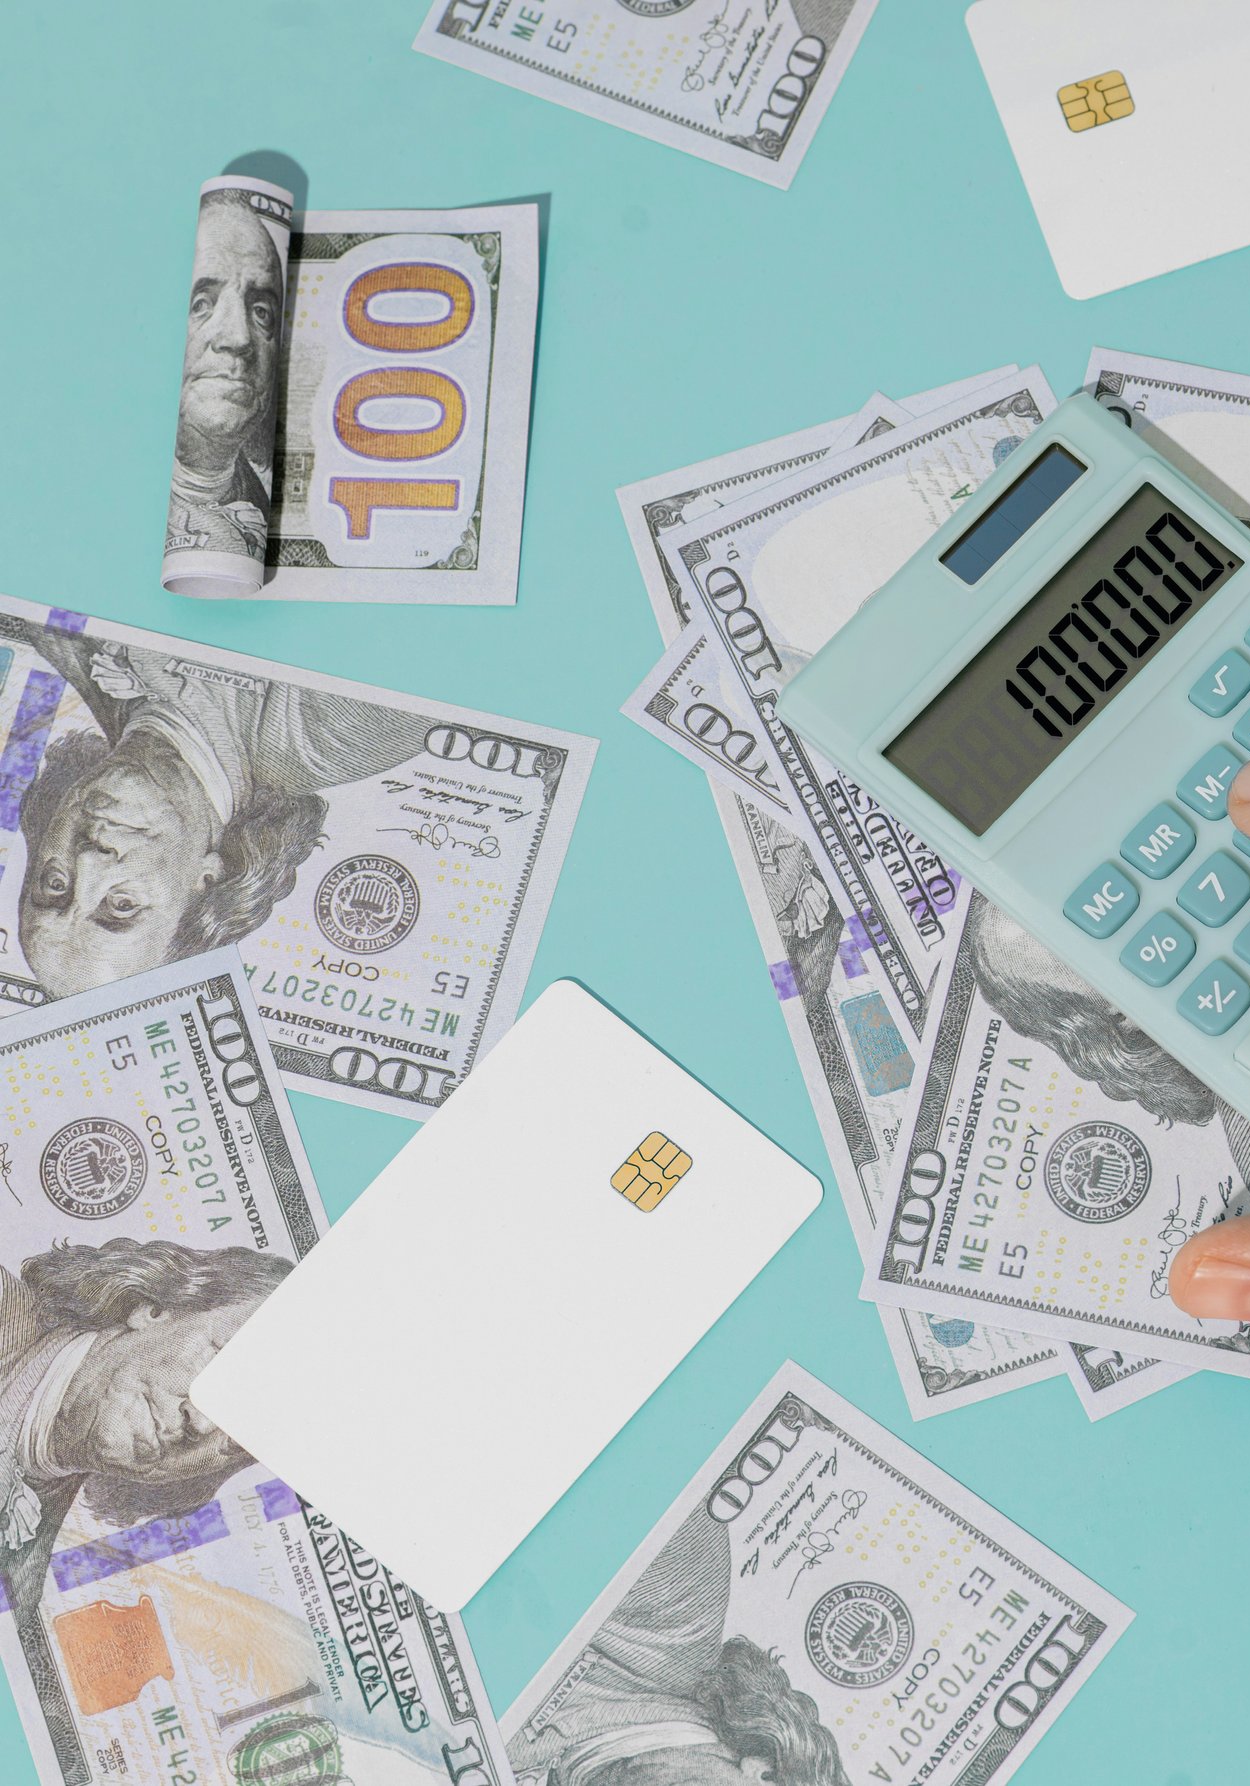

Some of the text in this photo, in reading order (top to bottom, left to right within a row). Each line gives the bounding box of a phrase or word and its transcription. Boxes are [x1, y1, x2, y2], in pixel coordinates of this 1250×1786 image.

[546, 18, 578, 54] E5
[756, 35, 826, 143] 100
[328, 262, 475, 540] 100
[705, 566, 782, 681] 100
[181, 663, 250, 688] FRANKLIN
[420, 719, 550, 783] 100
[758, 698, 830, 826] DOLLARS
[436, 774, 464, 790] United
[463, 781, 478, 793] the
[475, 784, 487, 795] of
[485, 787, 523, 804] Treasurer
[1194, 766, 1231, 803] M-
[432, 810, 446, 822] the
[443, 813, 456, 825] of
[455, 816, 491, 833] Secretary
[743, 801, 772, 859] RANKLIN
[1138, 824, 1181, 862] MR
[316, 851, 423, 927] FEDERAL RESERVE SYSTEM
[819, 821, 893, 954] HUNDRED
[860, 805, 950, 953] UNITED
[1082, 880, 1125, 922] MC
[1198, 872, 1226, 902] 7
[316, 914, 398, 958] UNITED STATES
[1139, 935, 1177, 963] %
[311, 952, 380, 983] COPY
[430, 968, 471, 1000] E5
[884, 954, 922, 1011] ONE
[142, 1018, 177, 1060] ME
[255, 1002, 450, 1062] FEDERAL RESERVE
[297, 1032, 308, 1047] D
[419, 1006, 461, 1038] ME
[104, 1034, 139, 1074] E5
[196, 985, 265, 1111] 100
[330, 1045, 456, 1104] 100
[179, 1009, 269, 1249] FEDERAL RESERVE NOTE
[945, 1096, 965, 1128] D 172
[102, 1119, 150, 1197] UNITED STATES
[142, 1111, 179, 1181] COPY
[238, 1131, 256, 1164] D 172
[881, 1127, 896, 1152] COPY
[931, 1016, 1002, 1267] FEDERAL RESERVE NOTE
[1013, 1121, 1047, 1193] COPY
[39, 1122, 119, 1222] FEDERAL RESERVE SYSTEM
[1040, 1123, 1086, 1205] UNITED STATES
[1076, 1122, 1152, 1226] FEDERAL RESERVE SYSTEM
[886, 1144, 952, 1275] 100
[957, 1232, 990, 1273] ME
[998, 1240, 1030, 1280] E5
[706, 1420, 803, 1524] 100
[785, 1479, 799, 1493] of
[792, 1448, 823, 1484] Treasurer
[759, 1498, 784, 1526] United
[778, 1487, 793, 1503] the
[809, 1489, 839, 1523] Secretary
[793, 1527, 809, 1543] the
[801, 1519, 815, 1533] of
[845, 1573, 900, 1623] FEDERAL
[954, 1563, 997, 1608] E5
[275, 1520, 343, 1704] FOR ALL PUBLIC AND PRIVATE
[292, 1538, 345, 1679] THIS NOTE IS LEGAL TENDER
[307, 1521, 393, 1717] AMERICA
[803, 1585, 849, 1637] RESERVE
[988, 1586, 1032, 1632] ME
[358, 1577, 433, 1737] STATES
[417, 1593, 474, 1718] OLLARS
[800, 1634, 853, 1683] SYSTEM
[851, 1616, 923, 1696] UNITED STATES
[886, 1643, 944, 1711] COPY
[994, 1614, 1089, 1730] 100
[533, 1662, 587, 1727] FRANKLIN
[915, 1609, 1053, 1781] FEDERAL RESERVE
[150, 1704, 185, 1746] ME
[960, 1735, 978, 1753] D
[94, 1747, 111, 1776] COPY
[102, 1746, 118, 1771] 2013
[109, 1736, 129, 1775] SERIES
